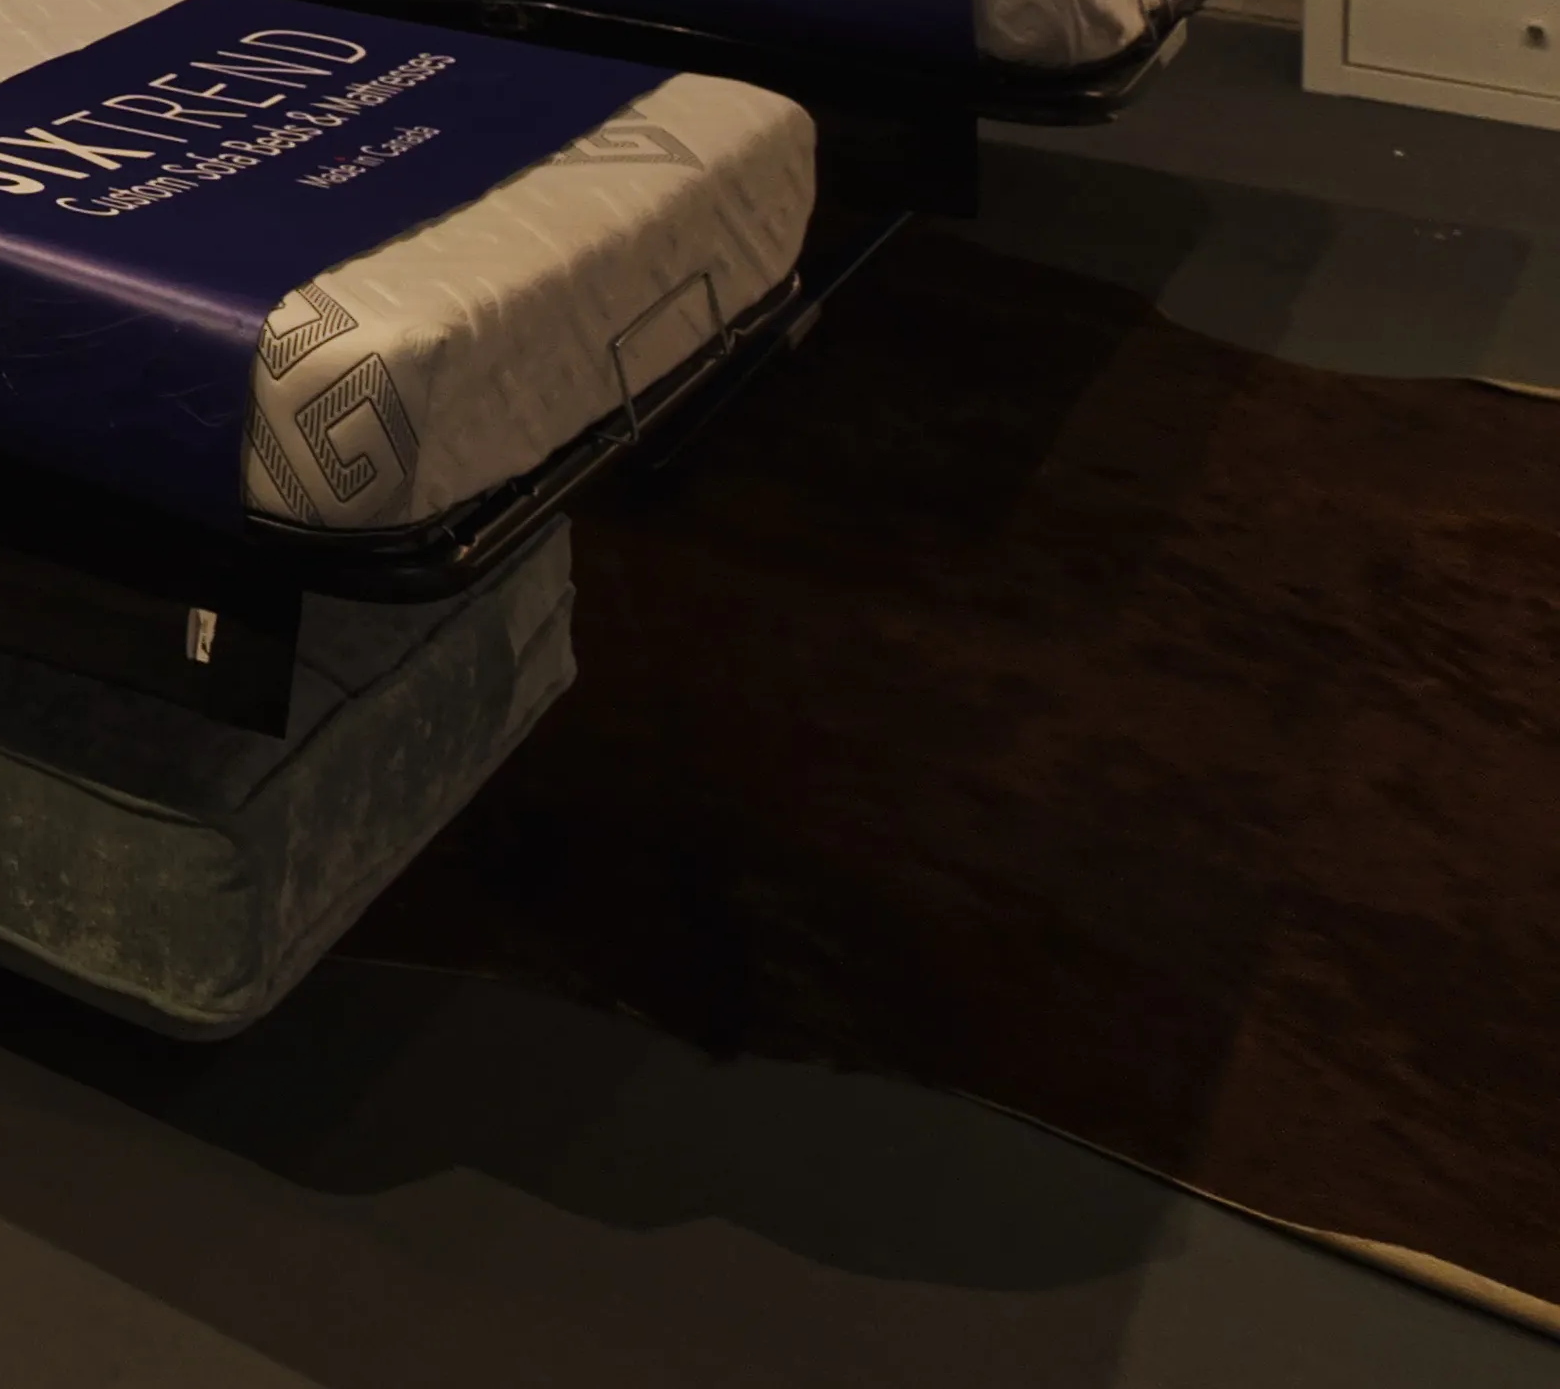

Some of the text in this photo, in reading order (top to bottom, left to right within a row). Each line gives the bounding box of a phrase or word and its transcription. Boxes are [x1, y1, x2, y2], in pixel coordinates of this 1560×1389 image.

[55, 52, 457, 217] Custom Sofa Beds & Mattresses
[294, 164, 366, 190] Made
[360, 124, 441, 159] Canada
